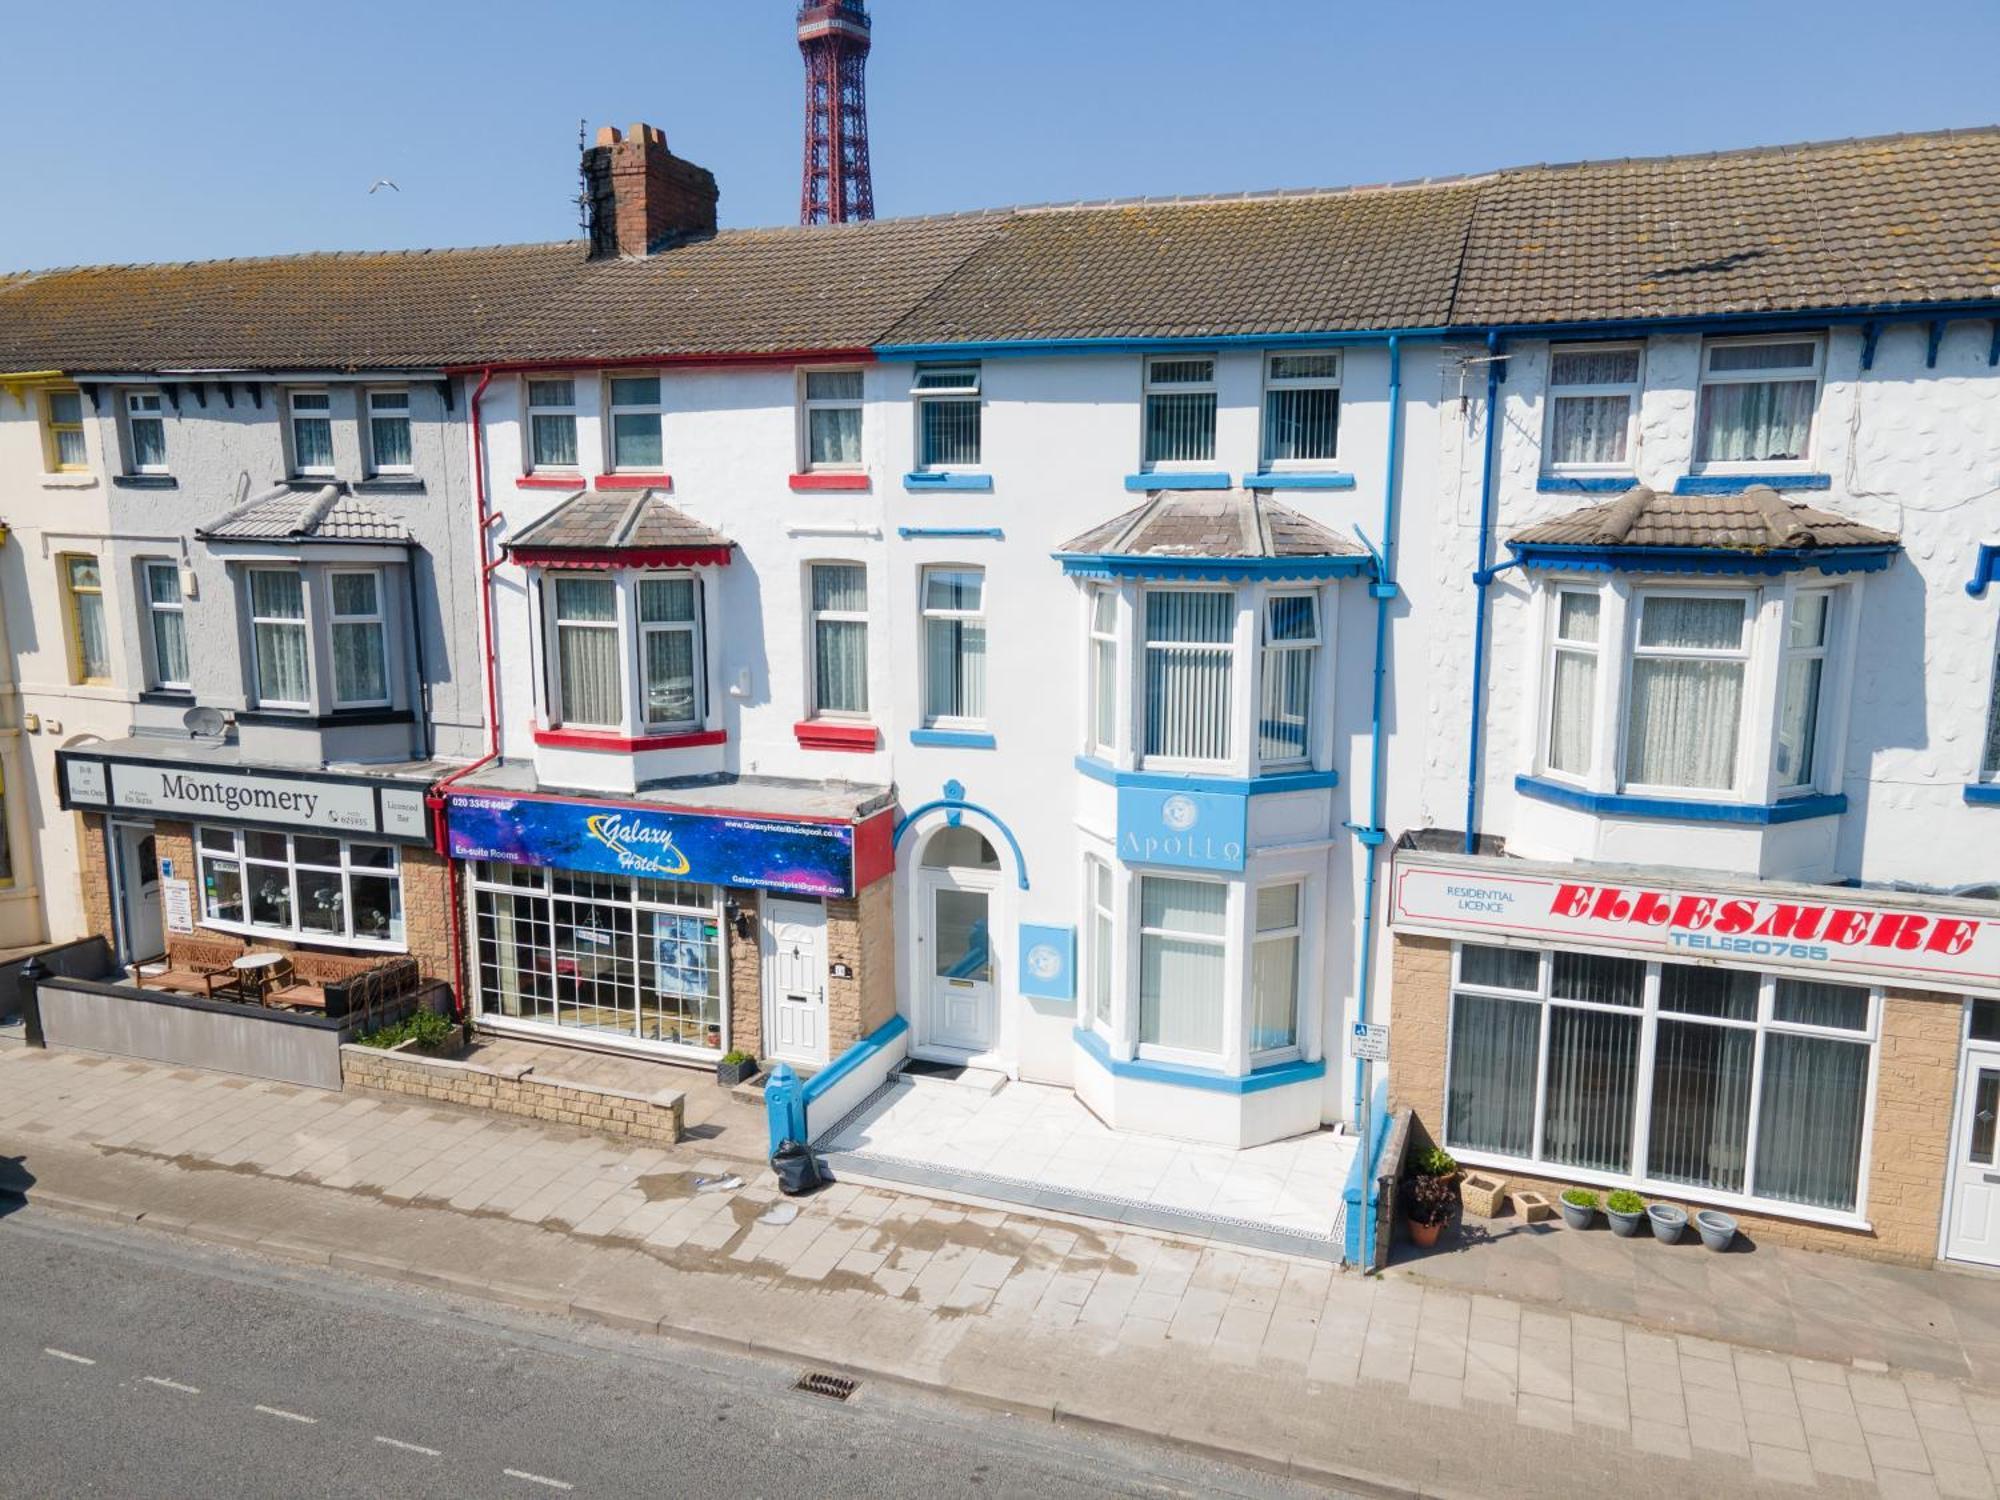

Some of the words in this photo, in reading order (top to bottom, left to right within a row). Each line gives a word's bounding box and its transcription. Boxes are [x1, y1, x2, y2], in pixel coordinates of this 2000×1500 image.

[161, 774, 319, 819] Montgomery
[453, 797, 468, 808] 020
[602, 814, 673, 853] Galaxy
[490, 848, 519, 860] Rooms
[618, 851, 660, 873] Hotel
[1446, 885, 1515, 902] RESIDENTIAL
[1458, 899, 1505, 913] LICENCE
[1549, 883, 1981, 956] ELLESMERE
